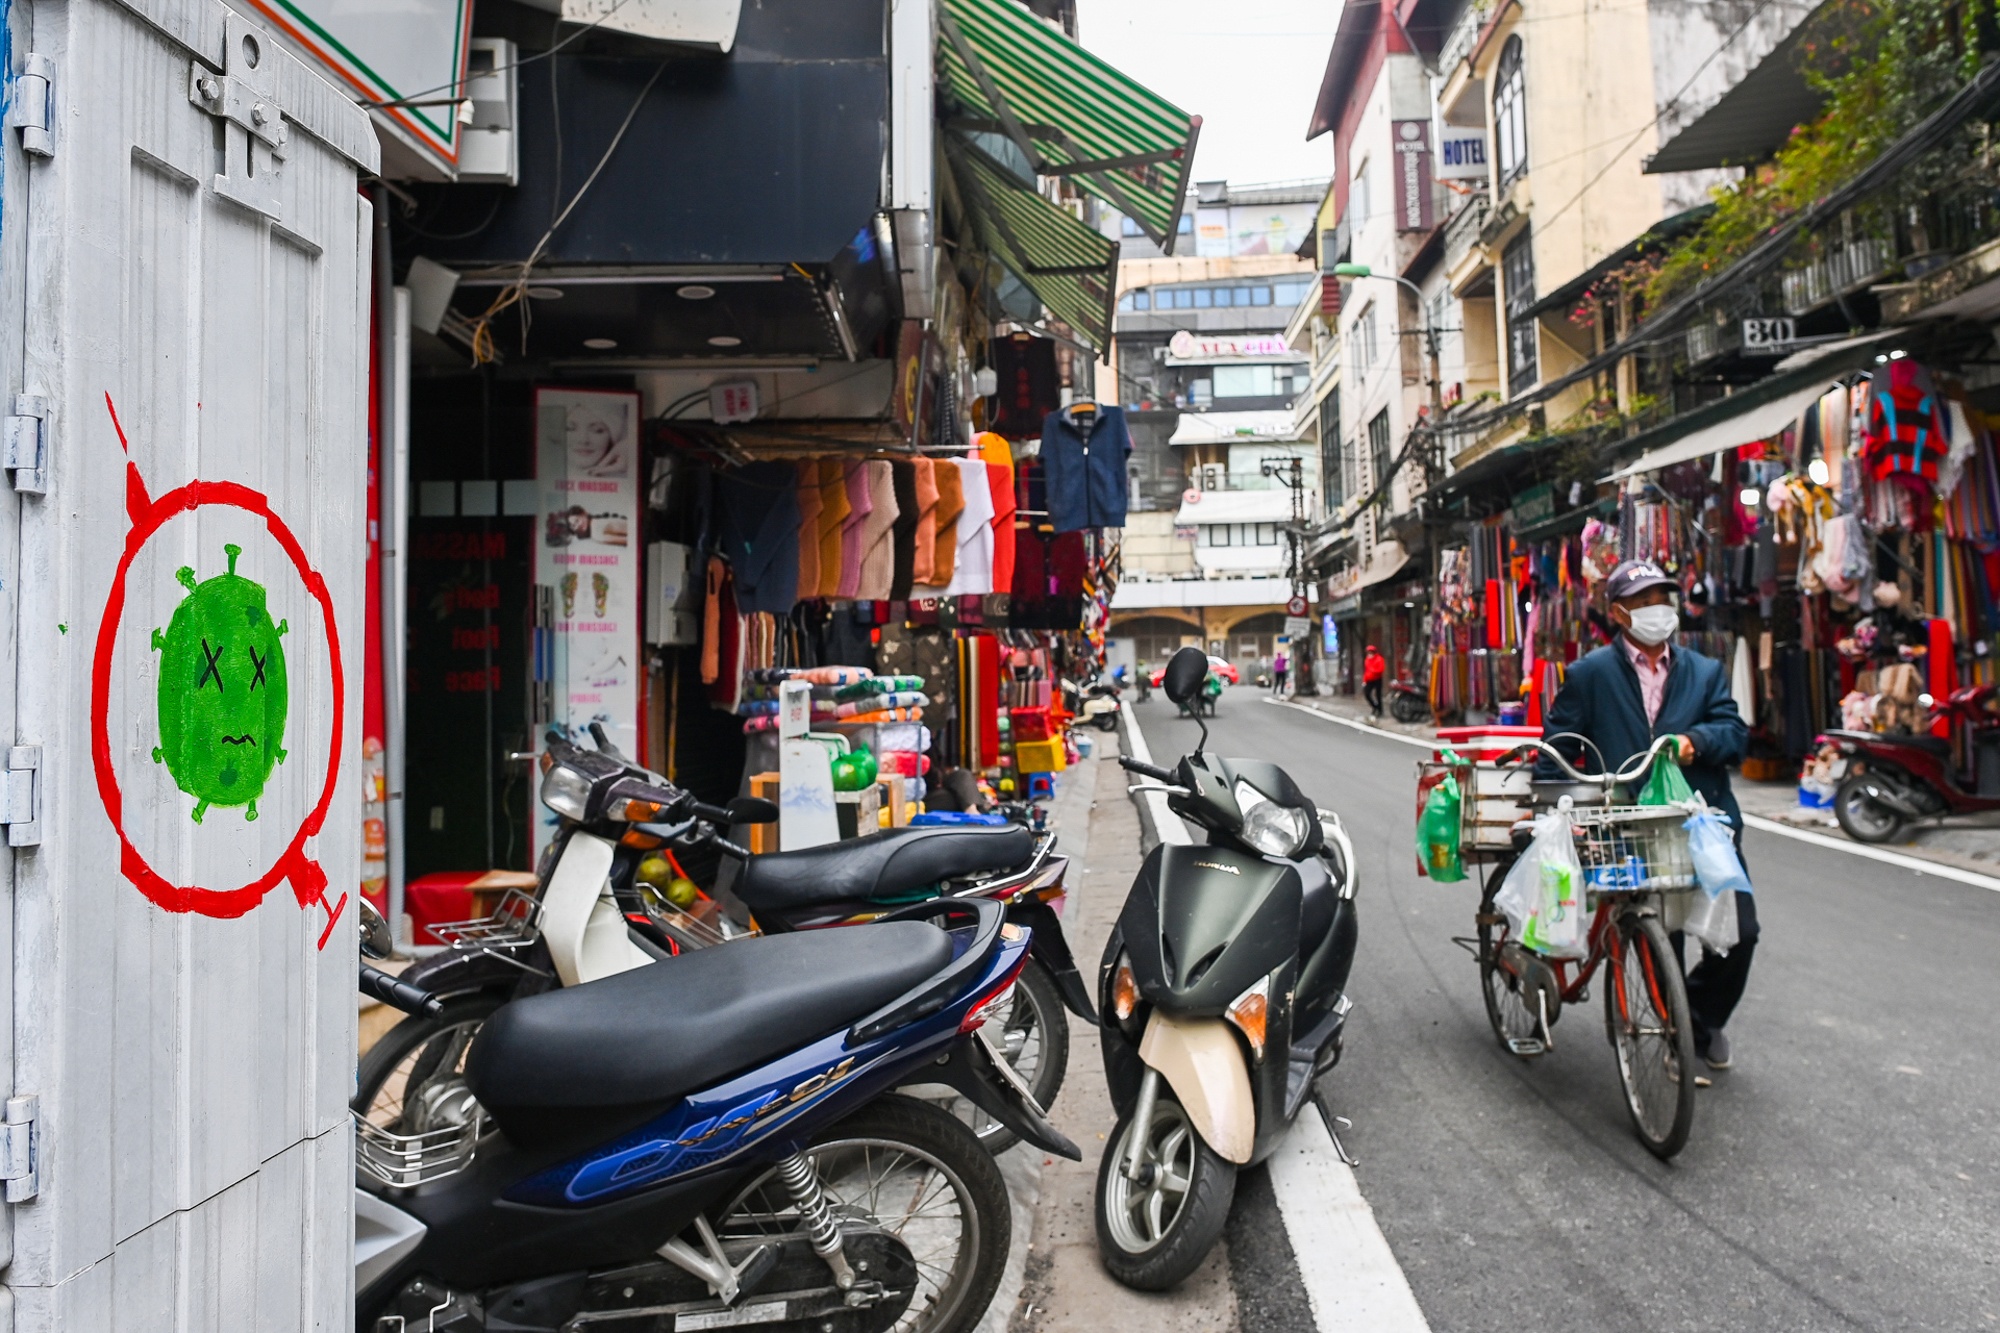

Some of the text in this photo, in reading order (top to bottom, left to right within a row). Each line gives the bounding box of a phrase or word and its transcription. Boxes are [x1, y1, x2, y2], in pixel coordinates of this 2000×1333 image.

[1395, 141, 1425, 153] HOTEL
[1443, 139, 1486, 165] HOTEL
[1627, 566, 1663, 581] FILA
[1193, 860, 1241, 876] HONDA
